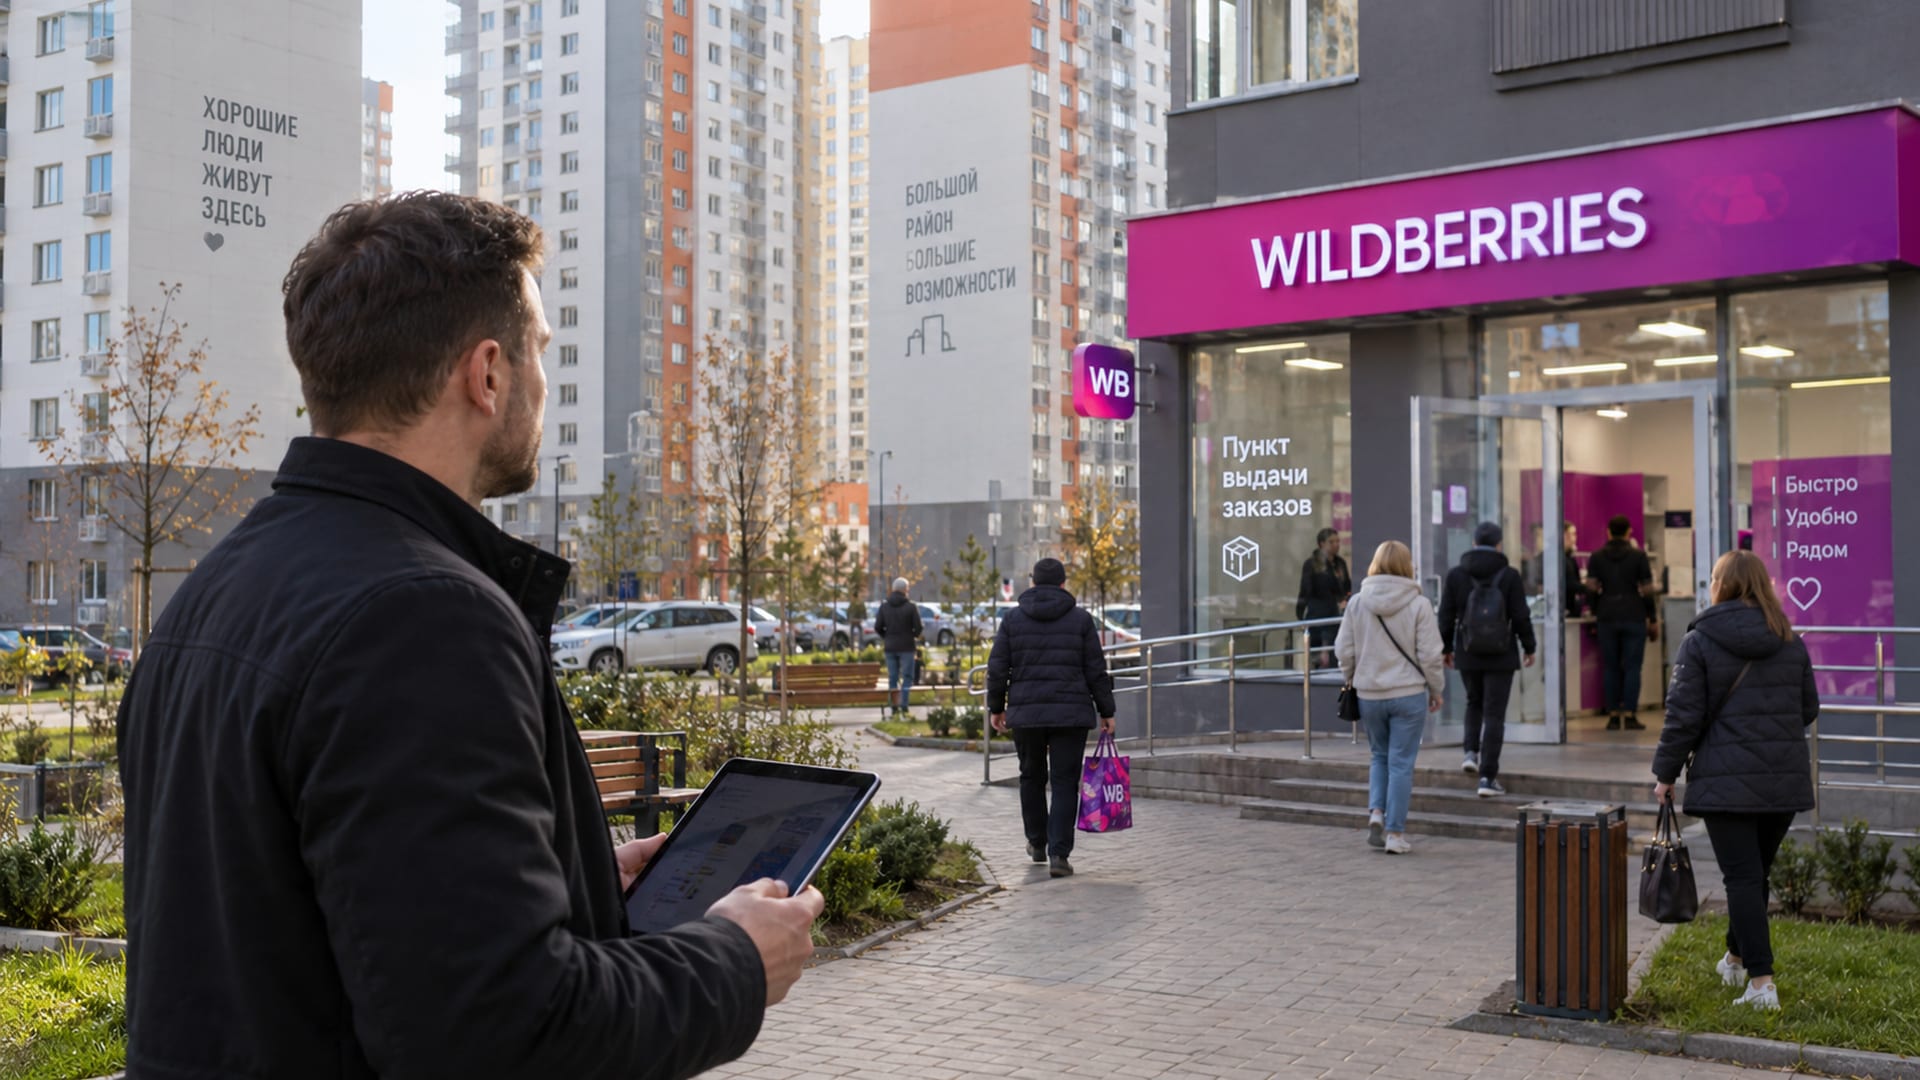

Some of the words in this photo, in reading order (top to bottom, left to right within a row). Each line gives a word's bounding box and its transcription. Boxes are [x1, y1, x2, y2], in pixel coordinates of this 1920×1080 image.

[203, 95, 298, 138] ХОРОШИЕ
[202, 129, 263, 163] ЛЮДИ
[202, 162, 272, 197] ЖИВУТ
[906, 167, 978, 206] БОЛЬШОЙ
[202, 196, 266, 228] ЗДЕСЬ
[906, 210, 953, 239] РАЙОН
[1251, 187, 1647, 289] WILDBERRIES
[906, 239, 976, 272] БОЛЬШИЕ
[906, 266, 1016, 305] ВОЗМОЖНОСТИ
[1089, 366, 1130, 398] WB
[1222, 435, 1290, 463] Пункт
[1222, 468, 1308, 490] выдачи
[1785, 475, 1857, 496] Быстро
[1222, 498, 1312, 518] заказов
[1785, 507, 1858, 528] Удобно
[1786, 541, 1848, 561] Рядом
[1102, 784, 1124, 803] WB
